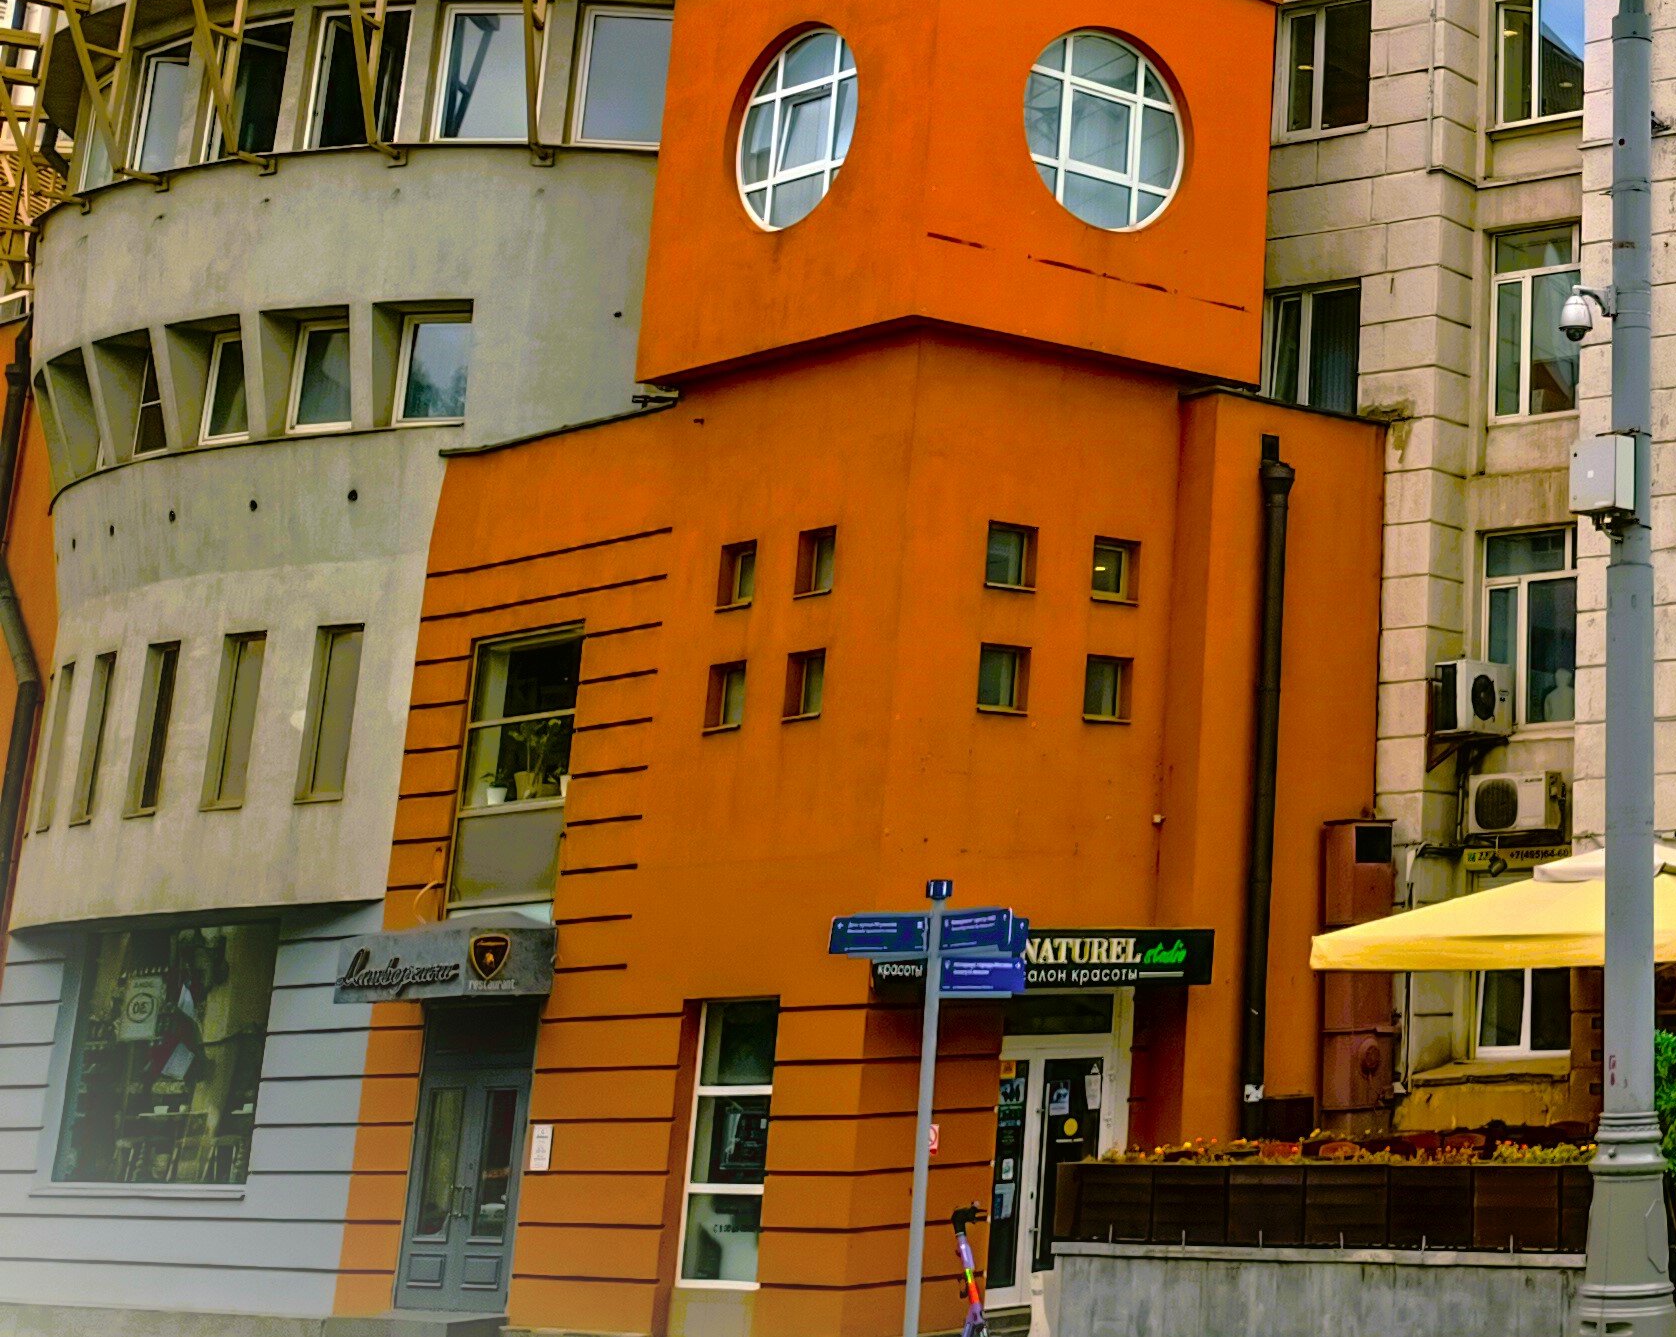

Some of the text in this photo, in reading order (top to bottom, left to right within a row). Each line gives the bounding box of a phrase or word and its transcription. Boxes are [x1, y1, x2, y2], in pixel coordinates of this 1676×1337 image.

[1023, 937, 1142, 964] NATUREL
[877, 964, 923, 979] красоты
[1071, 968, 1138, 985] красоты
